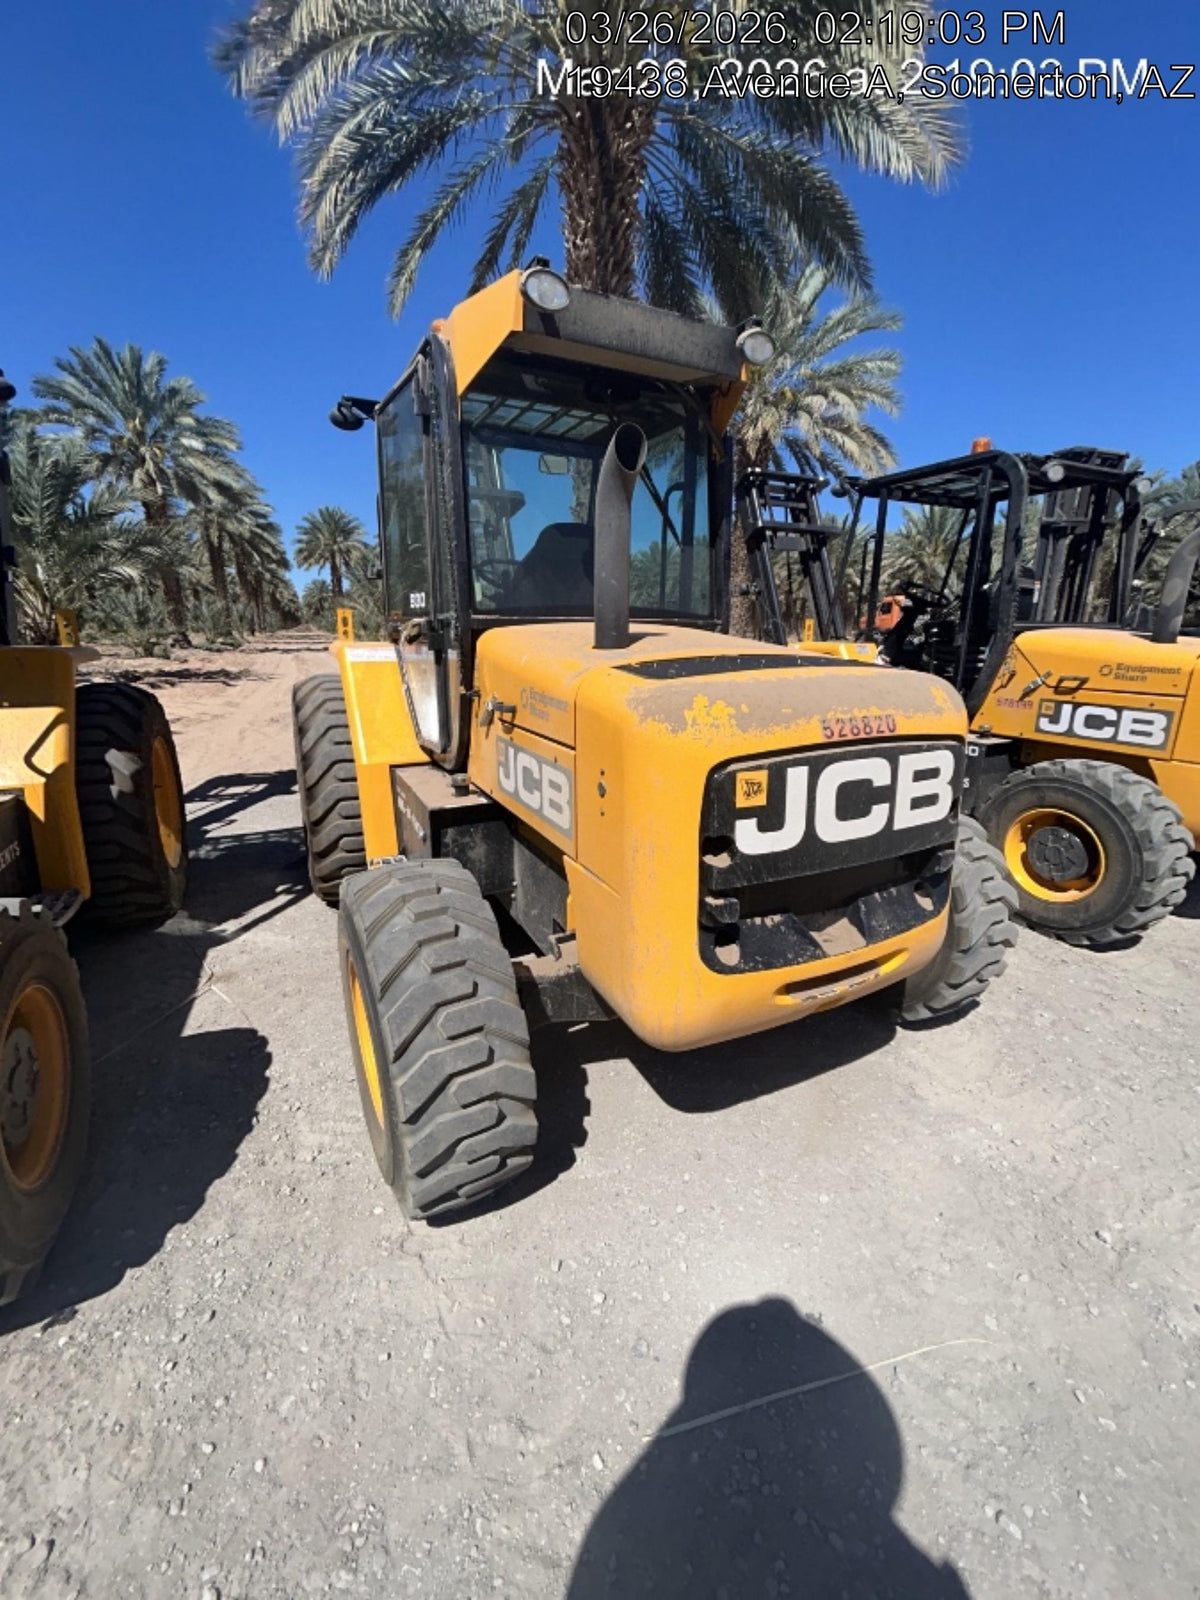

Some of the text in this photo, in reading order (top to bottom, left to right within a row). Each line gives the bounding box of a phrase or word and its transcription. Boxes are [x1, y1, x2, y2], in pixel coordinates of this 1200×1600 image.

[1037, 702, 1169, 747] JCB
[498, 745, 572, 830] JCB
[734, 749, 956, 856] JCB
